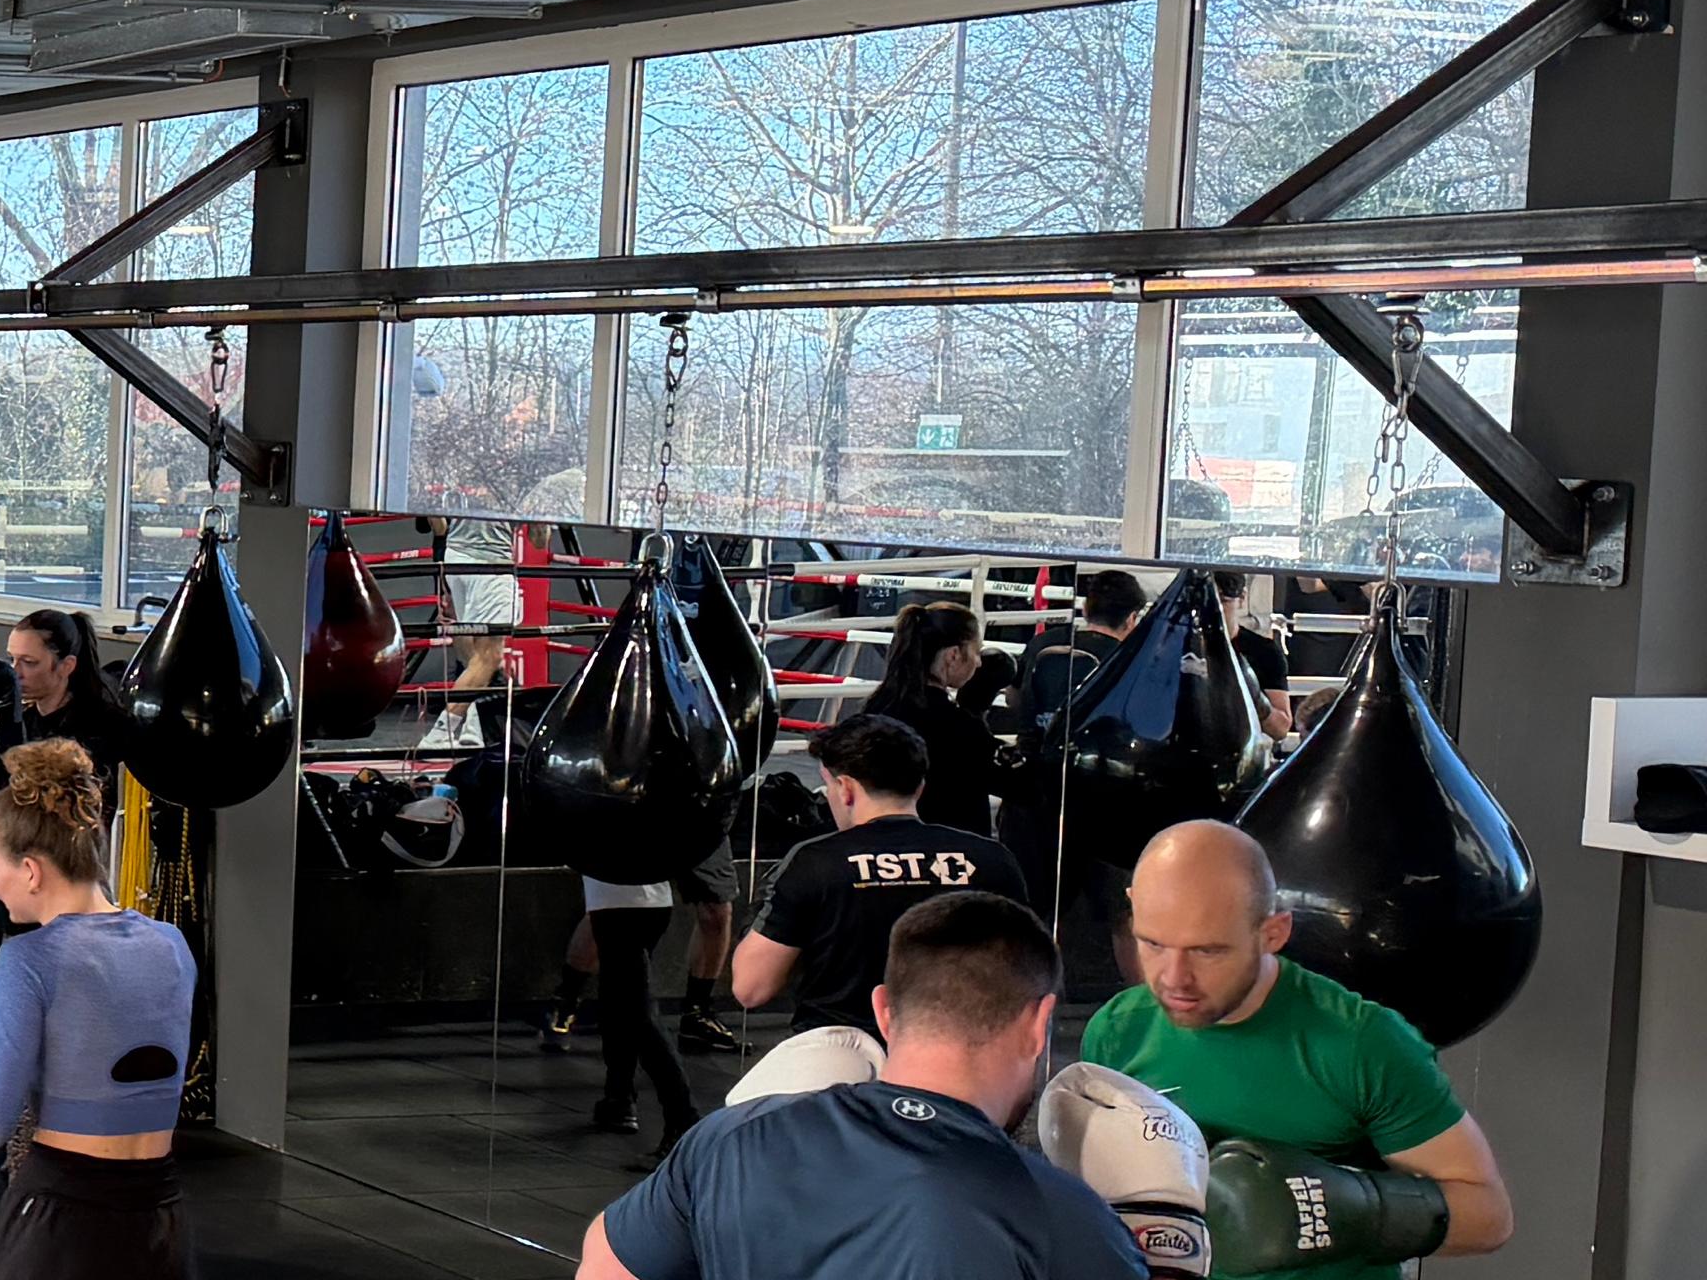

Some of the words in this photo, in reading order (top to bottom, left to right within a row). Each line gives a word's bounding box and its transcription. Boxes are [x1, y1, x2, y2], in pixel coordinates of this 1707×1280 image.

[847, 853, 925, 880] TST
[1285, 1177, 1315, 1251] PAFFEN
[1303, 1175, 1332, 1249] SPORT
